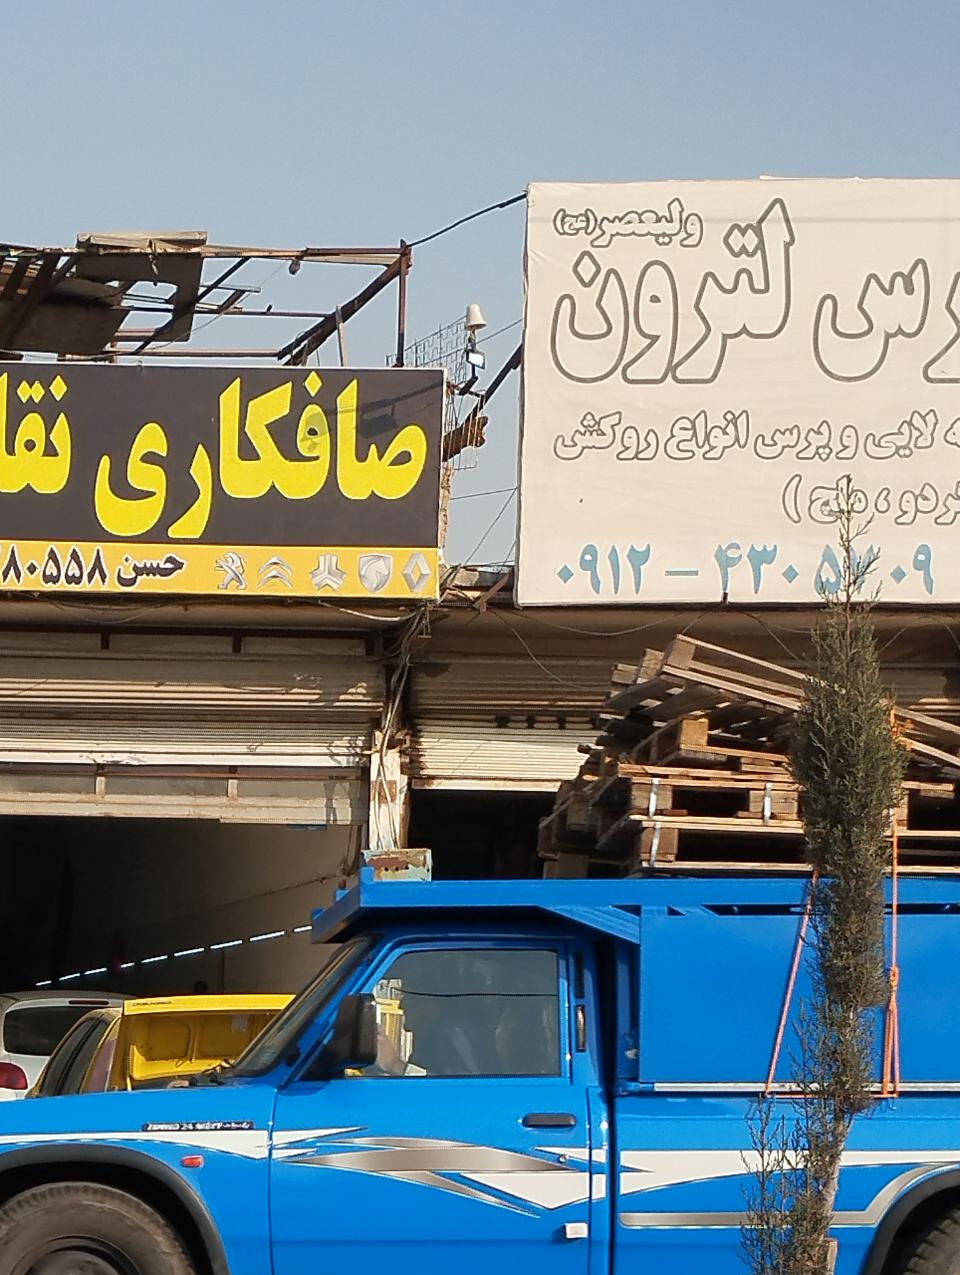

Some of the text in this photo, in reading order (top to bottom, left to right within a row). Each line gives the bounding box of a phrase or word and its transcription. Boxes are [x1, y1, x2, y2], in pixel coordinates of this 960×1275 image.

[94, 370, 428, 539] صافکاری
[554, 411, 659, 460] روکش
[664, 410, 749, 460] انواع
[754, 420, 832, 462] پرس
[835, 424, 859, 460] و
[116, 553, 186, 588] حسن
